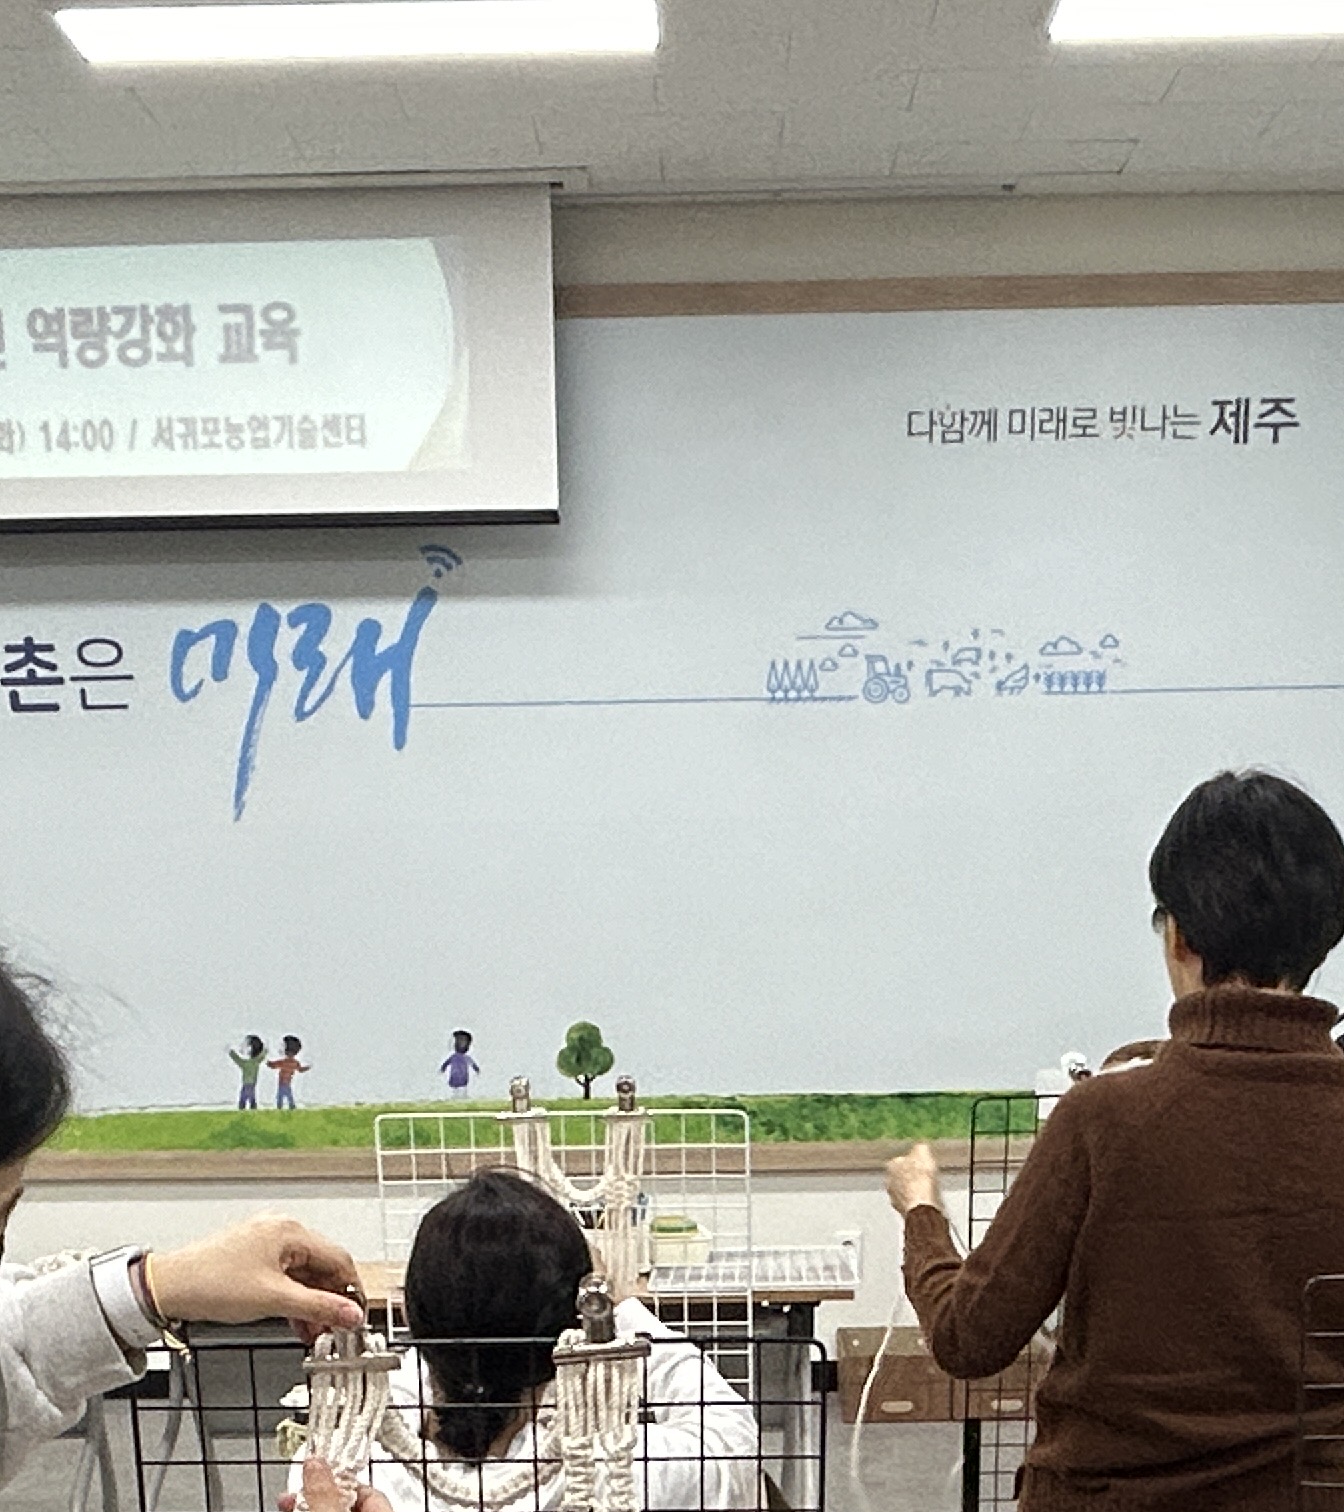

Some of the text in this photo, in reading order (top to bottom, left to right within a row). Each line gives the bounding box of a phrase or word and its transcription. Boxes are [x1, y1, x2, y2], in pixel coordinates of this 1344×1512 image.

[26, 303, 197, 369] 역량강화
[216, 301, 301, 365] 교육
[38, 417, 115, 453] 14:00
[151, 412, 368, 452] 서귀포농업기술센터
[906, 397, 1301, 445] 다함께 미래로 빛나는 제주
[169, 587, 440, 822] 미래
